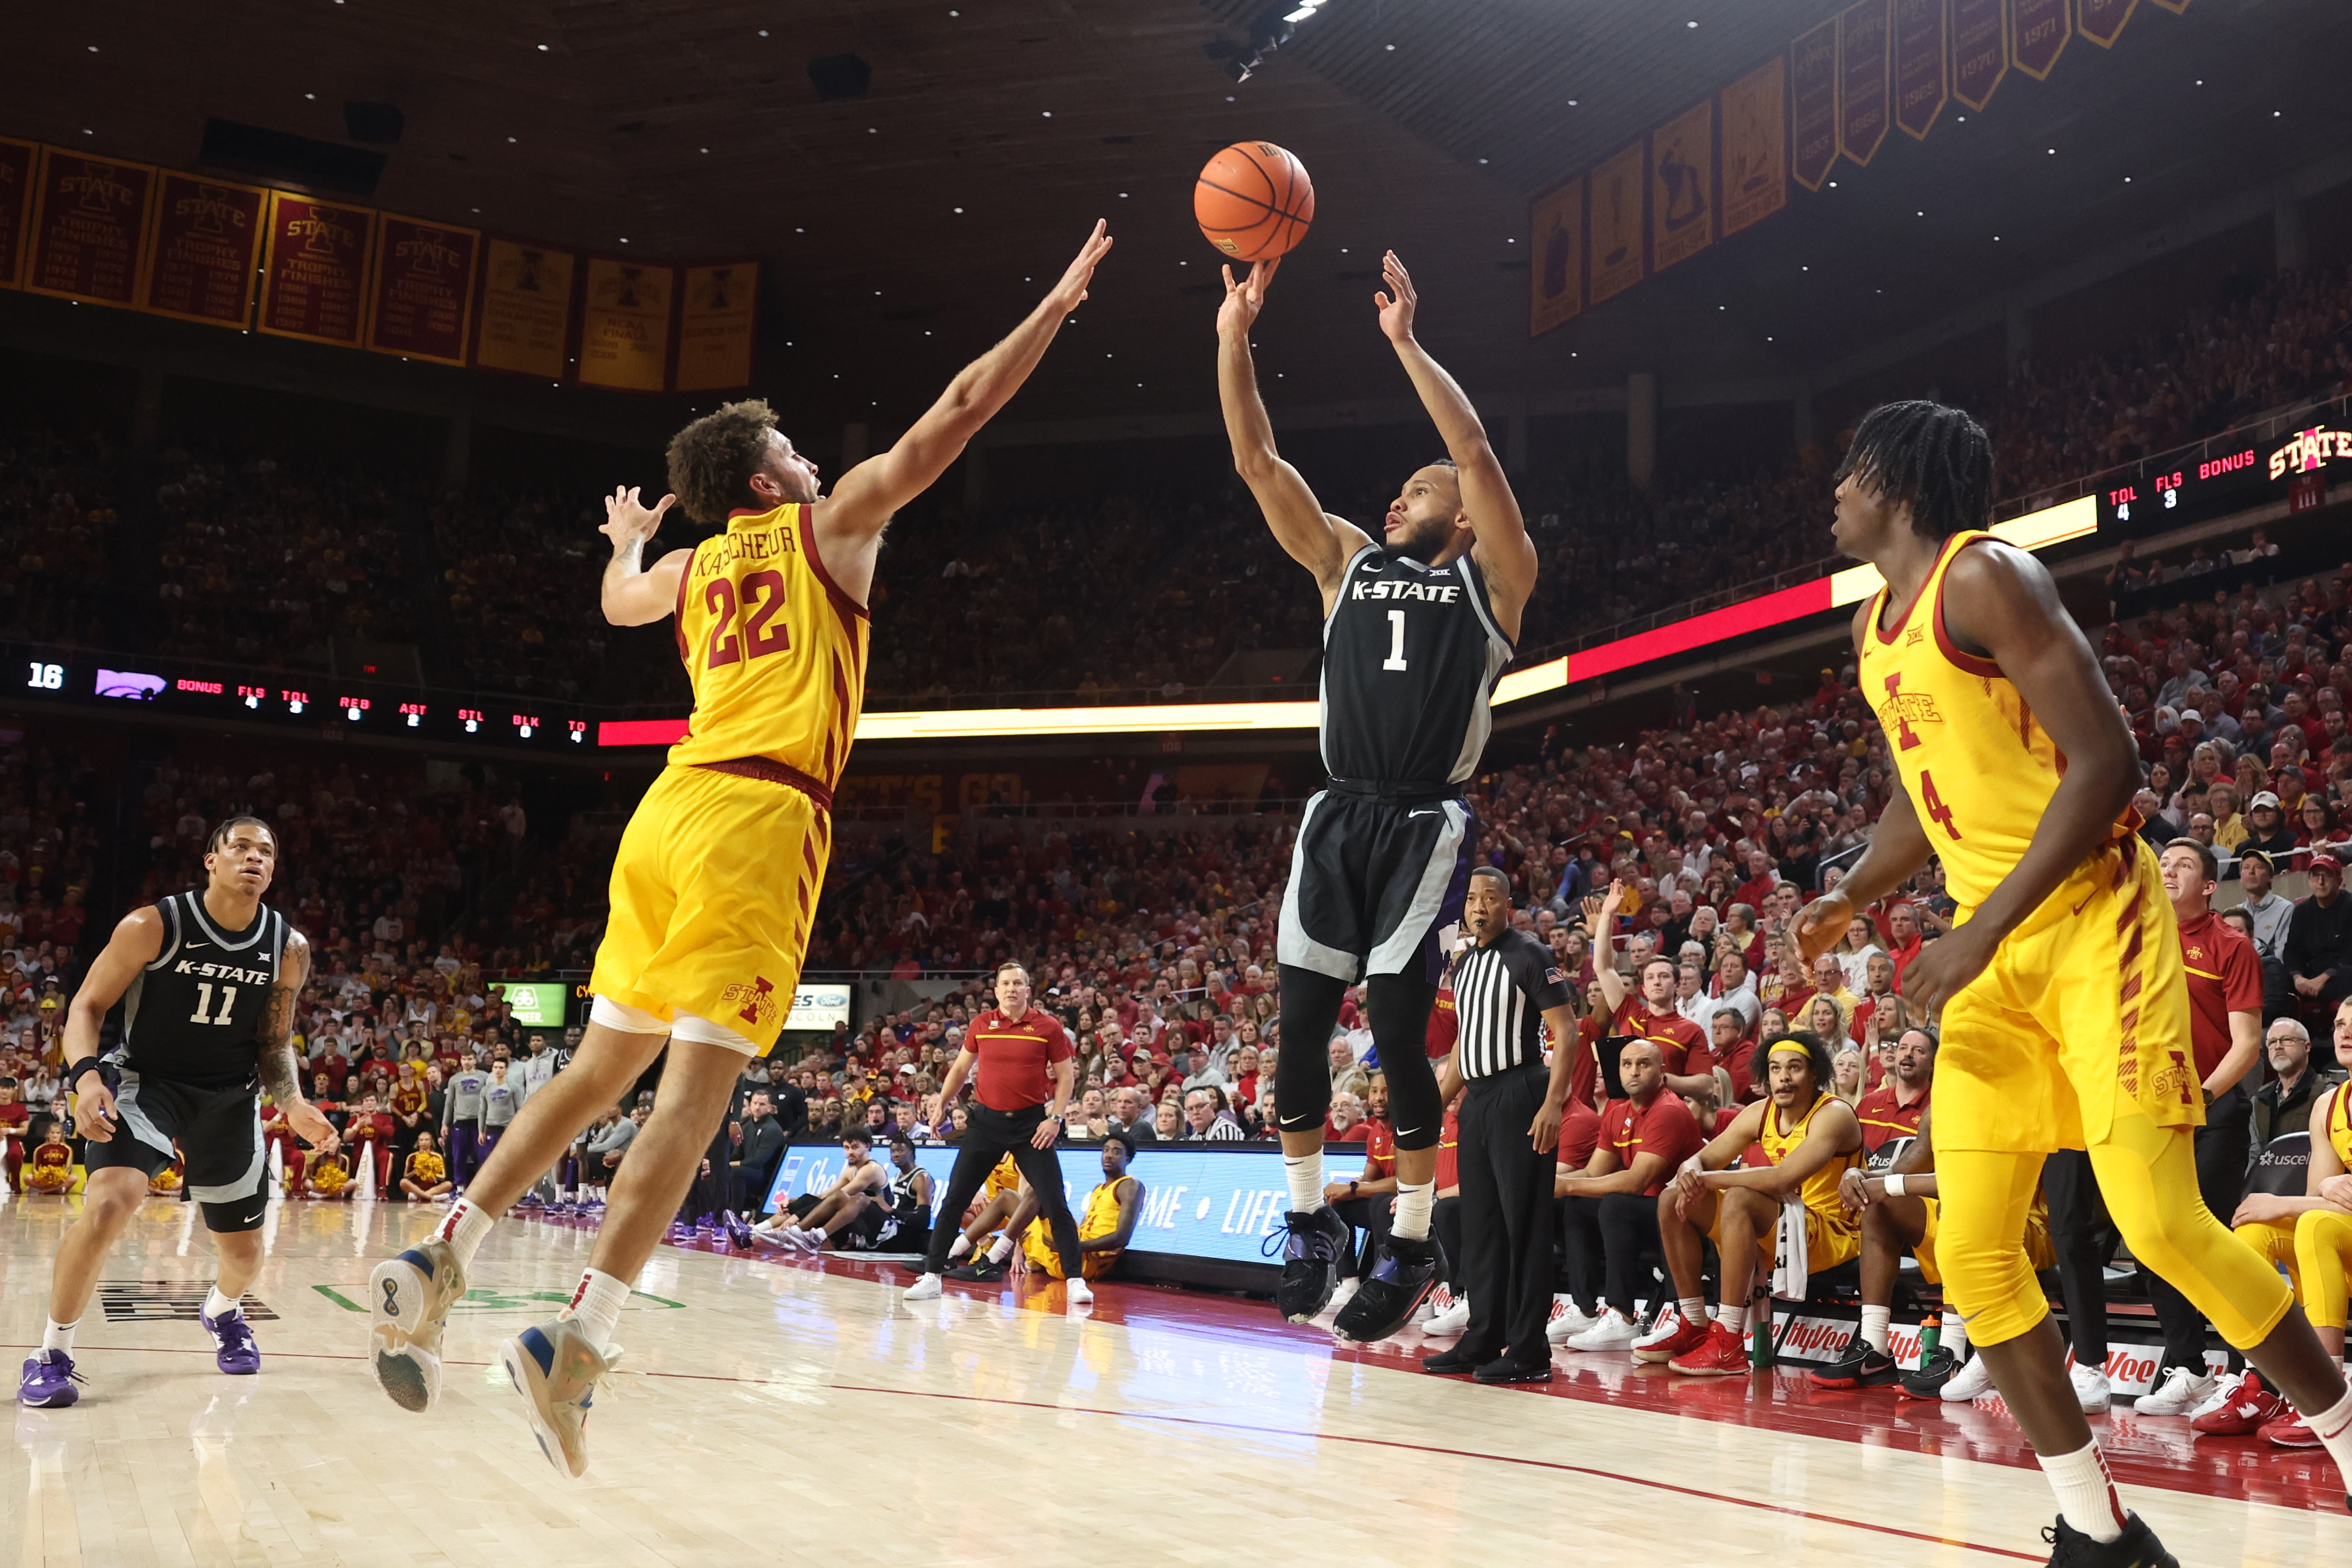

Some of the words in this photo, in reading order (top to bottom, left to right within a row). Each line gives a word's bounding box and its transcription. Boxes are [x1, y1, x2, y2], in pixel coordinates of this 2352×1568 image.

[2025, 17, 2056, 47] 1971
[1961, 49, 1995, 79] 1970
[59, 176, 133, 206] STATE
[175, 198, 246, 228] STATE
[58, 215, 126, 236] TROPHY
[287, 220, 354, 247] STATE
[52, 225, 129, 250] FINISHES
[174, 237, 238, 258] TROPHY
[168, 249, 241, 271] FINISHES
[395, 240, 460, 269] STATE
[282, 268, 352, 289] FINISHES
[287, 258, 349, 278] TROPHY
[397, 278, 453, 298] TROPHY
[389, 289, 457, 309] FINISHES
[2199, 450, 2254, 480] BONUS
[2269, 431, 2352, 481] STATE
[2155, 471, 2182, 492] FLS
[2110, 486, 2137, 506] TOL
[2165, 489, 2177, 509] 3
[2117, 503, 2130, 521] 4
[696, 527, 796, 577] KASCHEUR
[1352, 580, 1460, 604] K-STATE
[705, 569, 790, 671] 22
[1383, 610, 1407, 671] 1
[27, 662, 63, 690] 16
[176, 679, 224, 694] BONUS
[238, 686, 266, 698] FLS
[281, 690, 309, 704] TOL
[245, 697, 258, 709] 4
[289, 701, 302, 714] 3
[339, 697, 371, 710] REB
[399, 703, 427, 715] AST
[407, 714, 420, 726] 2
[458, 709, 485, 722] STL
[513, 715, 539, 727] BLK
[1878, 693, 1943, 736] STATE
[466, 720, 477, 733] 3
[520, 725, 531, 738] 0
[568, 720, 586, 731] TO
[571, 730, 581, 743] 4
[836, 774, 942, 814] ET'S
[960, 773, 1022, 813] GO
[1921, 769, 1962, 840] 4
[2186, 948, 2204, 959] STATE
[175, 960, 269, 985] K-STATE
[190, 982, 237, 1025] 11
[722, 984, 779, 1027] STATE
[1140, 1186, 1188, 1229] ME
[1221, 1189, 1287, 1237] LIFE
